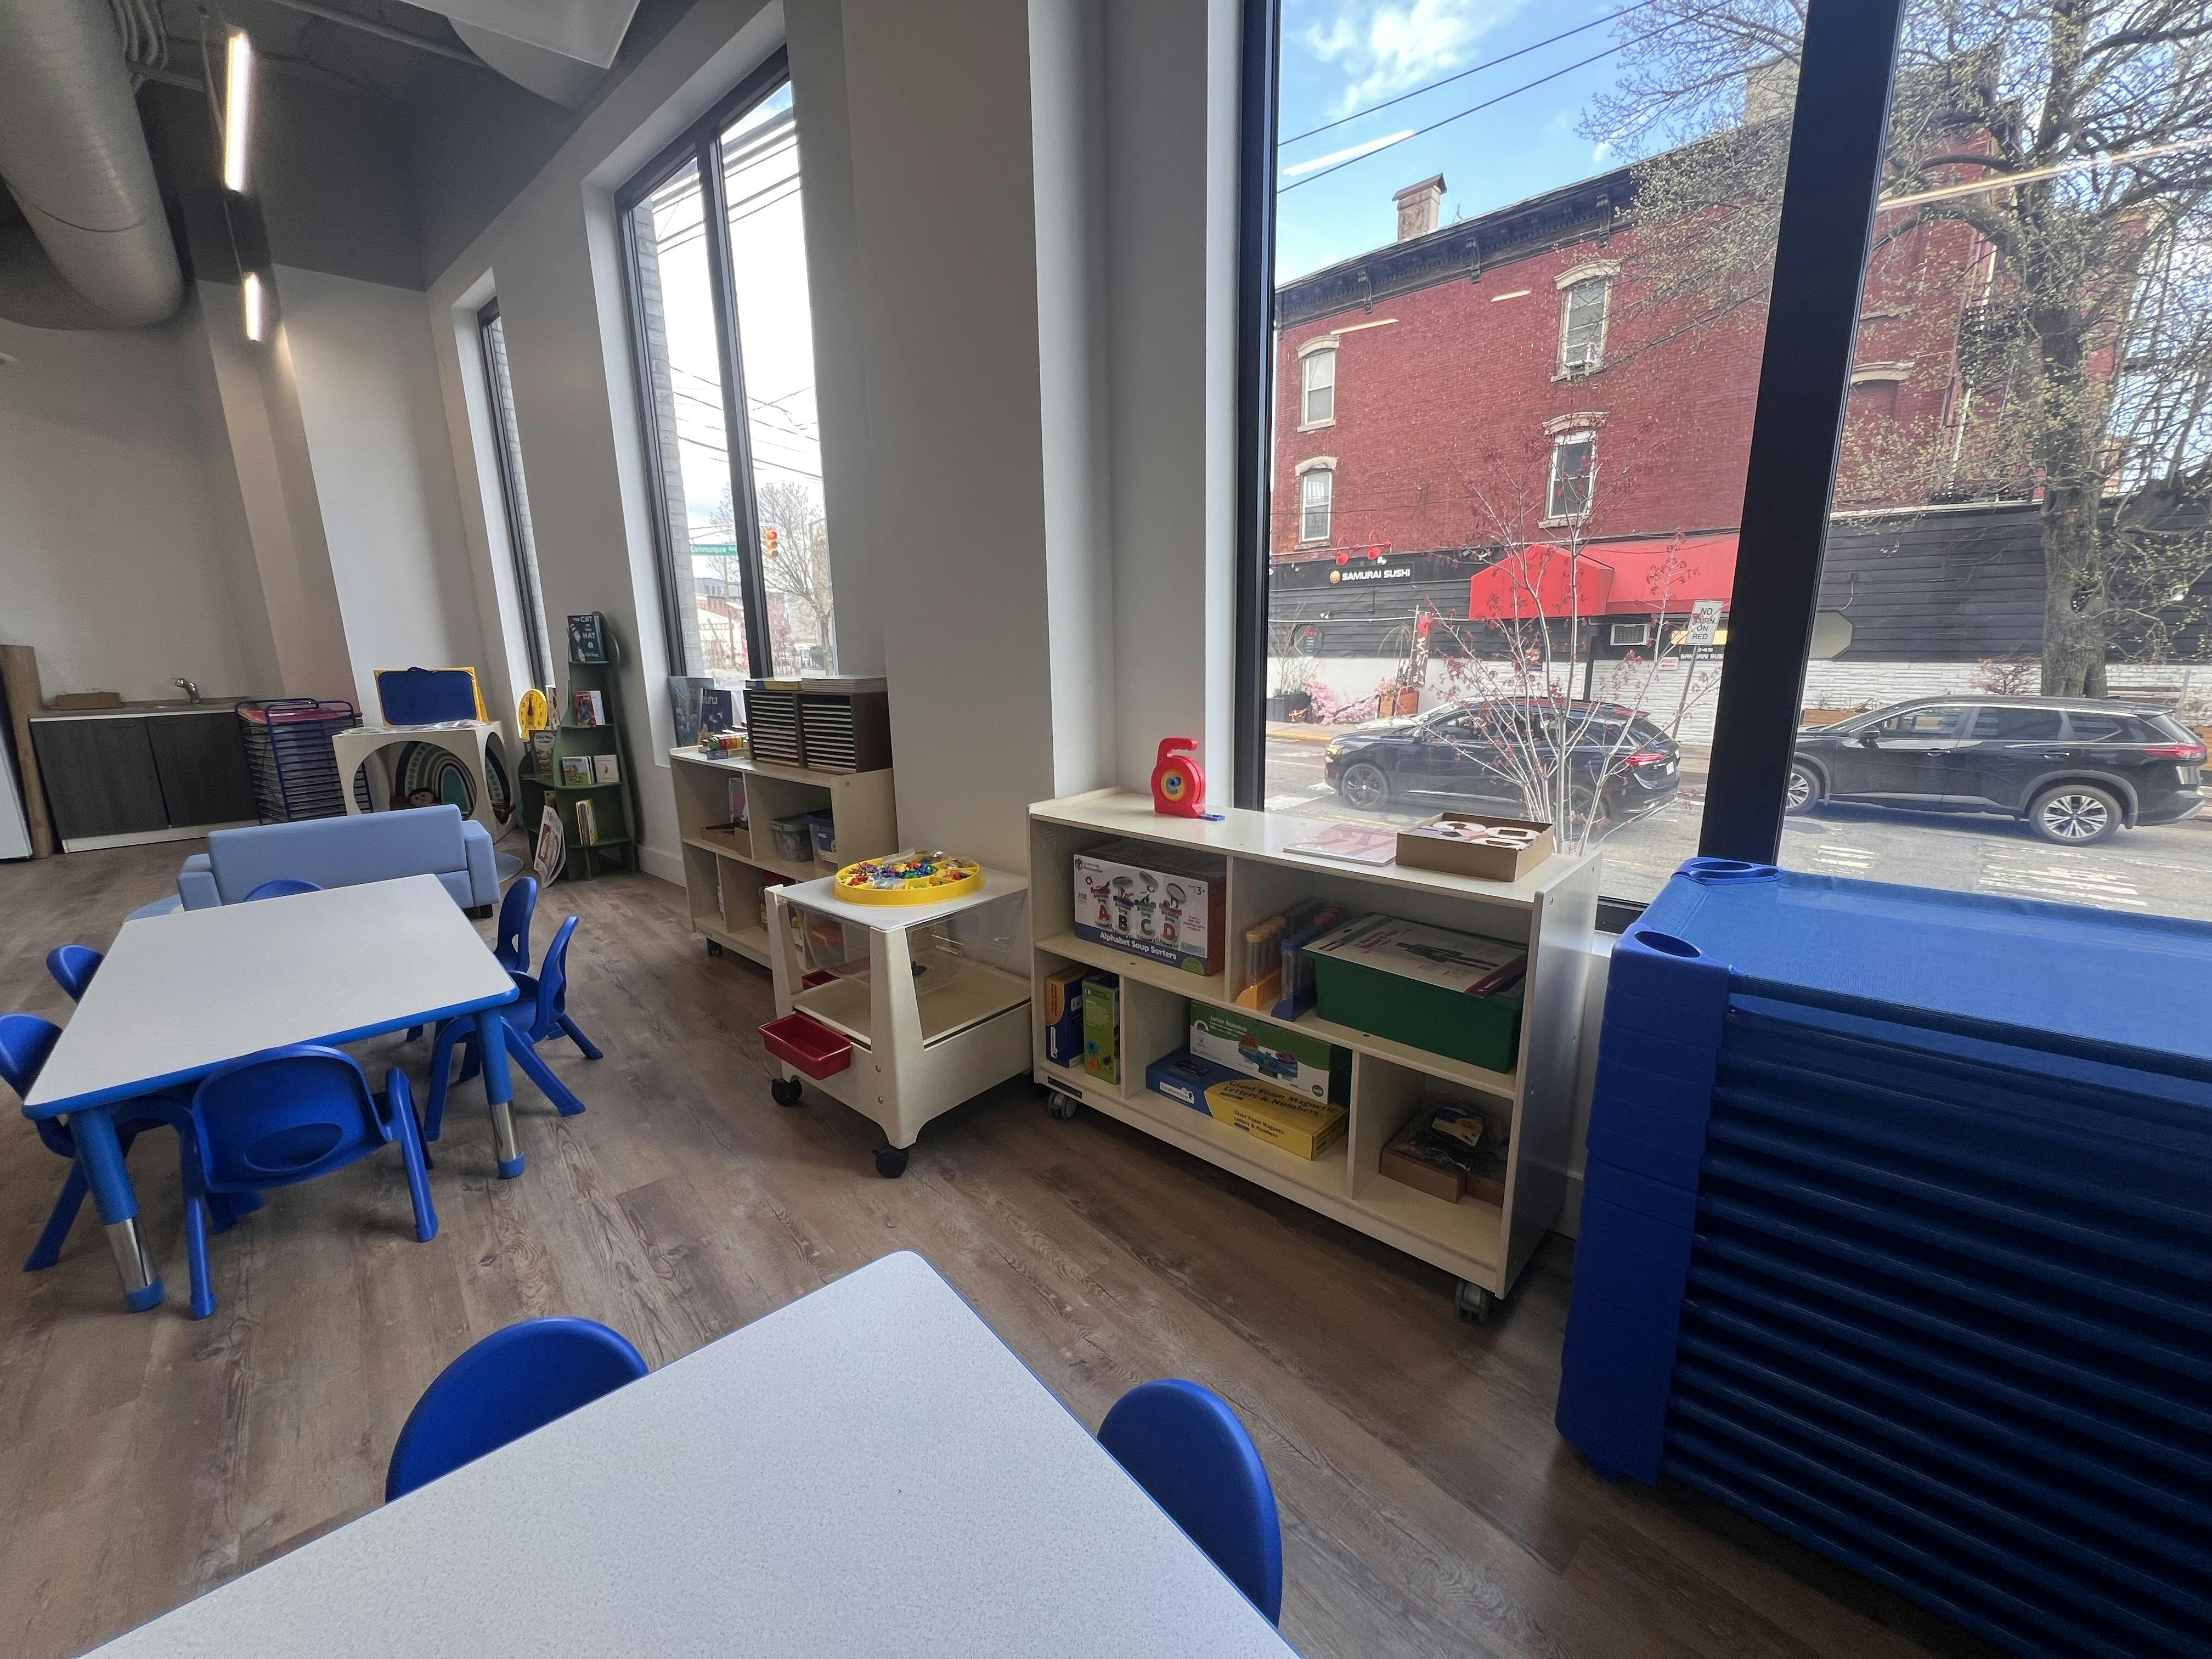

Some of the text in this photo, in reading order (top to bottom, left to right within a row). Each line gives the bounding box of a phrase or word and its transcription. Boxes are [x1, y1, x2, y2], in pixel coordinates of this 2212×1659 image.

[1342, 569, 1410, 581] SAMURAI SUSHI
[1197, 887, 1206, 895] 3+
[1099, 904, 1110, 921] A
[1118, 915, 1128, 932] B
[1141, 918, 1151, 935] C
[1163, 923, 1175, 940] D
[1099, 932, 1130, 946] Alphabet
[1131, 940, 1149, 953] Soup
[1150, 944, 1177, 960] Sorters
[1210, 1015, 1224, 1025] Junior
[1224, 1086, 1257, 1099] Letters
[1272, 1099, 1319, 1116] Numbers
[1229, 1080, 1335, 1114] Giant Foam Magnetic
[1234, 1110, 1285, 1135] Giant Foam Magnetic
[1234, 1116, 1250, 1126] Letters
[1256, 1126, 1278, 1138] Numbers
